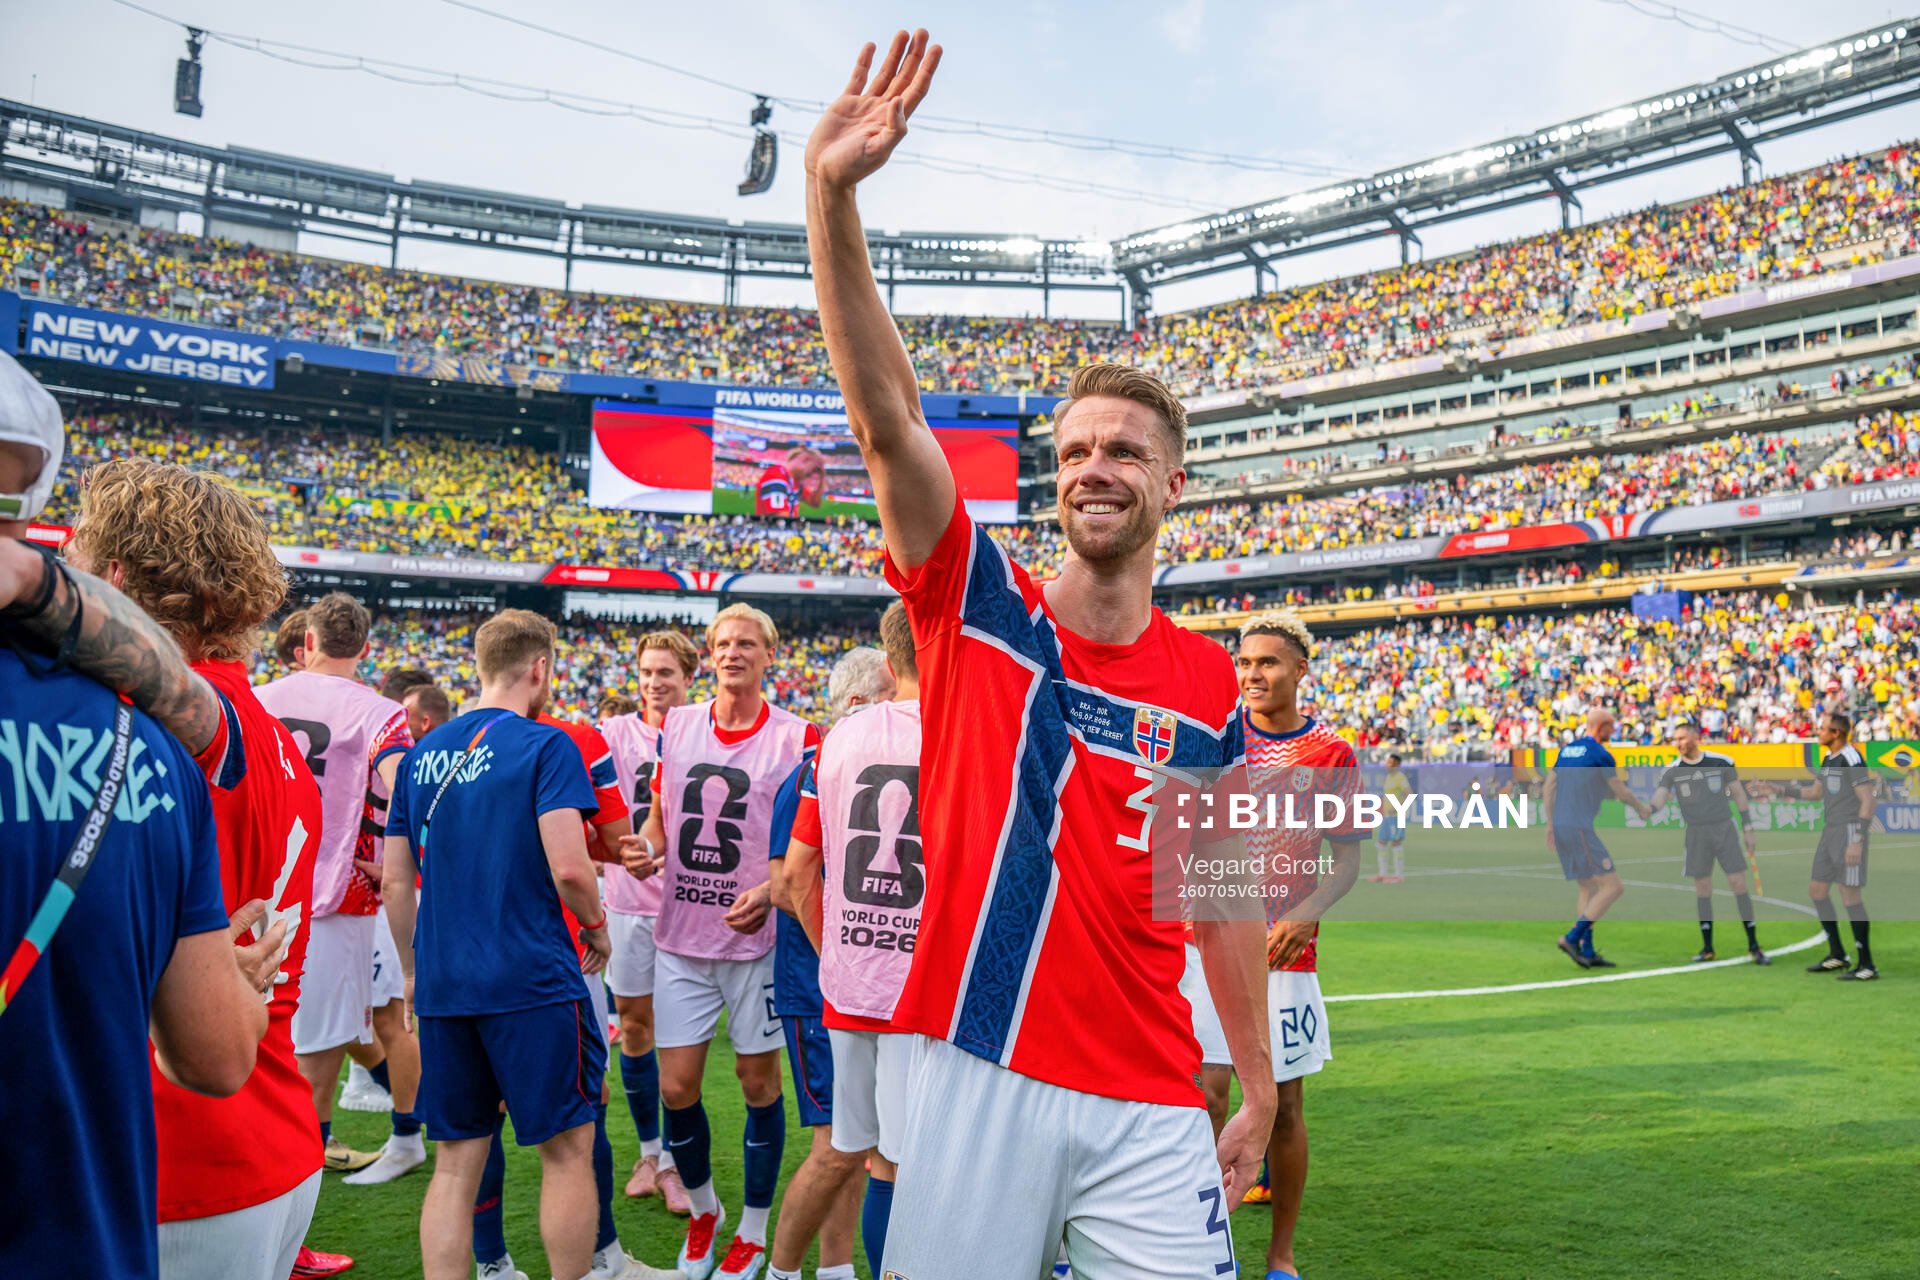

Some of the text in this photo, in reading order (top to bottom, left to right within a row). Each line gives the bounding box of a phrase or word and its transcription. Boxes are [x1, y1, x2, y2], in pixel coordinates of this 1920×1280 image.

[32, 312, 268, 366] NEW YORK
[30, 337, 268, 386] NEW JERSEY
[716, 390, 752, 405] FIFA
[753, 392, 813, 408] WORLD
[1851, 488, 1884, 504] FIFA
[392, 558, 417, 571] FIFA
[419, 559, 459, 573] WORLD
[1300, 544, 1421, 567] FIFA WORLD CUP 2026
[1102, 729, 1124, 740] JERSEY
[70, 708, 131, 868] FIFA WORLD CUP 2026
[1887, 807, 1920, 830] UN
[691, 850, 722, 865] FIFA
[676, 873, 738, 890] WORLD CUP
[861, 877, 903, 896] FIFA
[675, 886, 737, 907] 2026
[892, 916, 921, 930] CUP
[841, 925, 917, 953] 2026
[1280, 1004, 1317, 1048] 20
